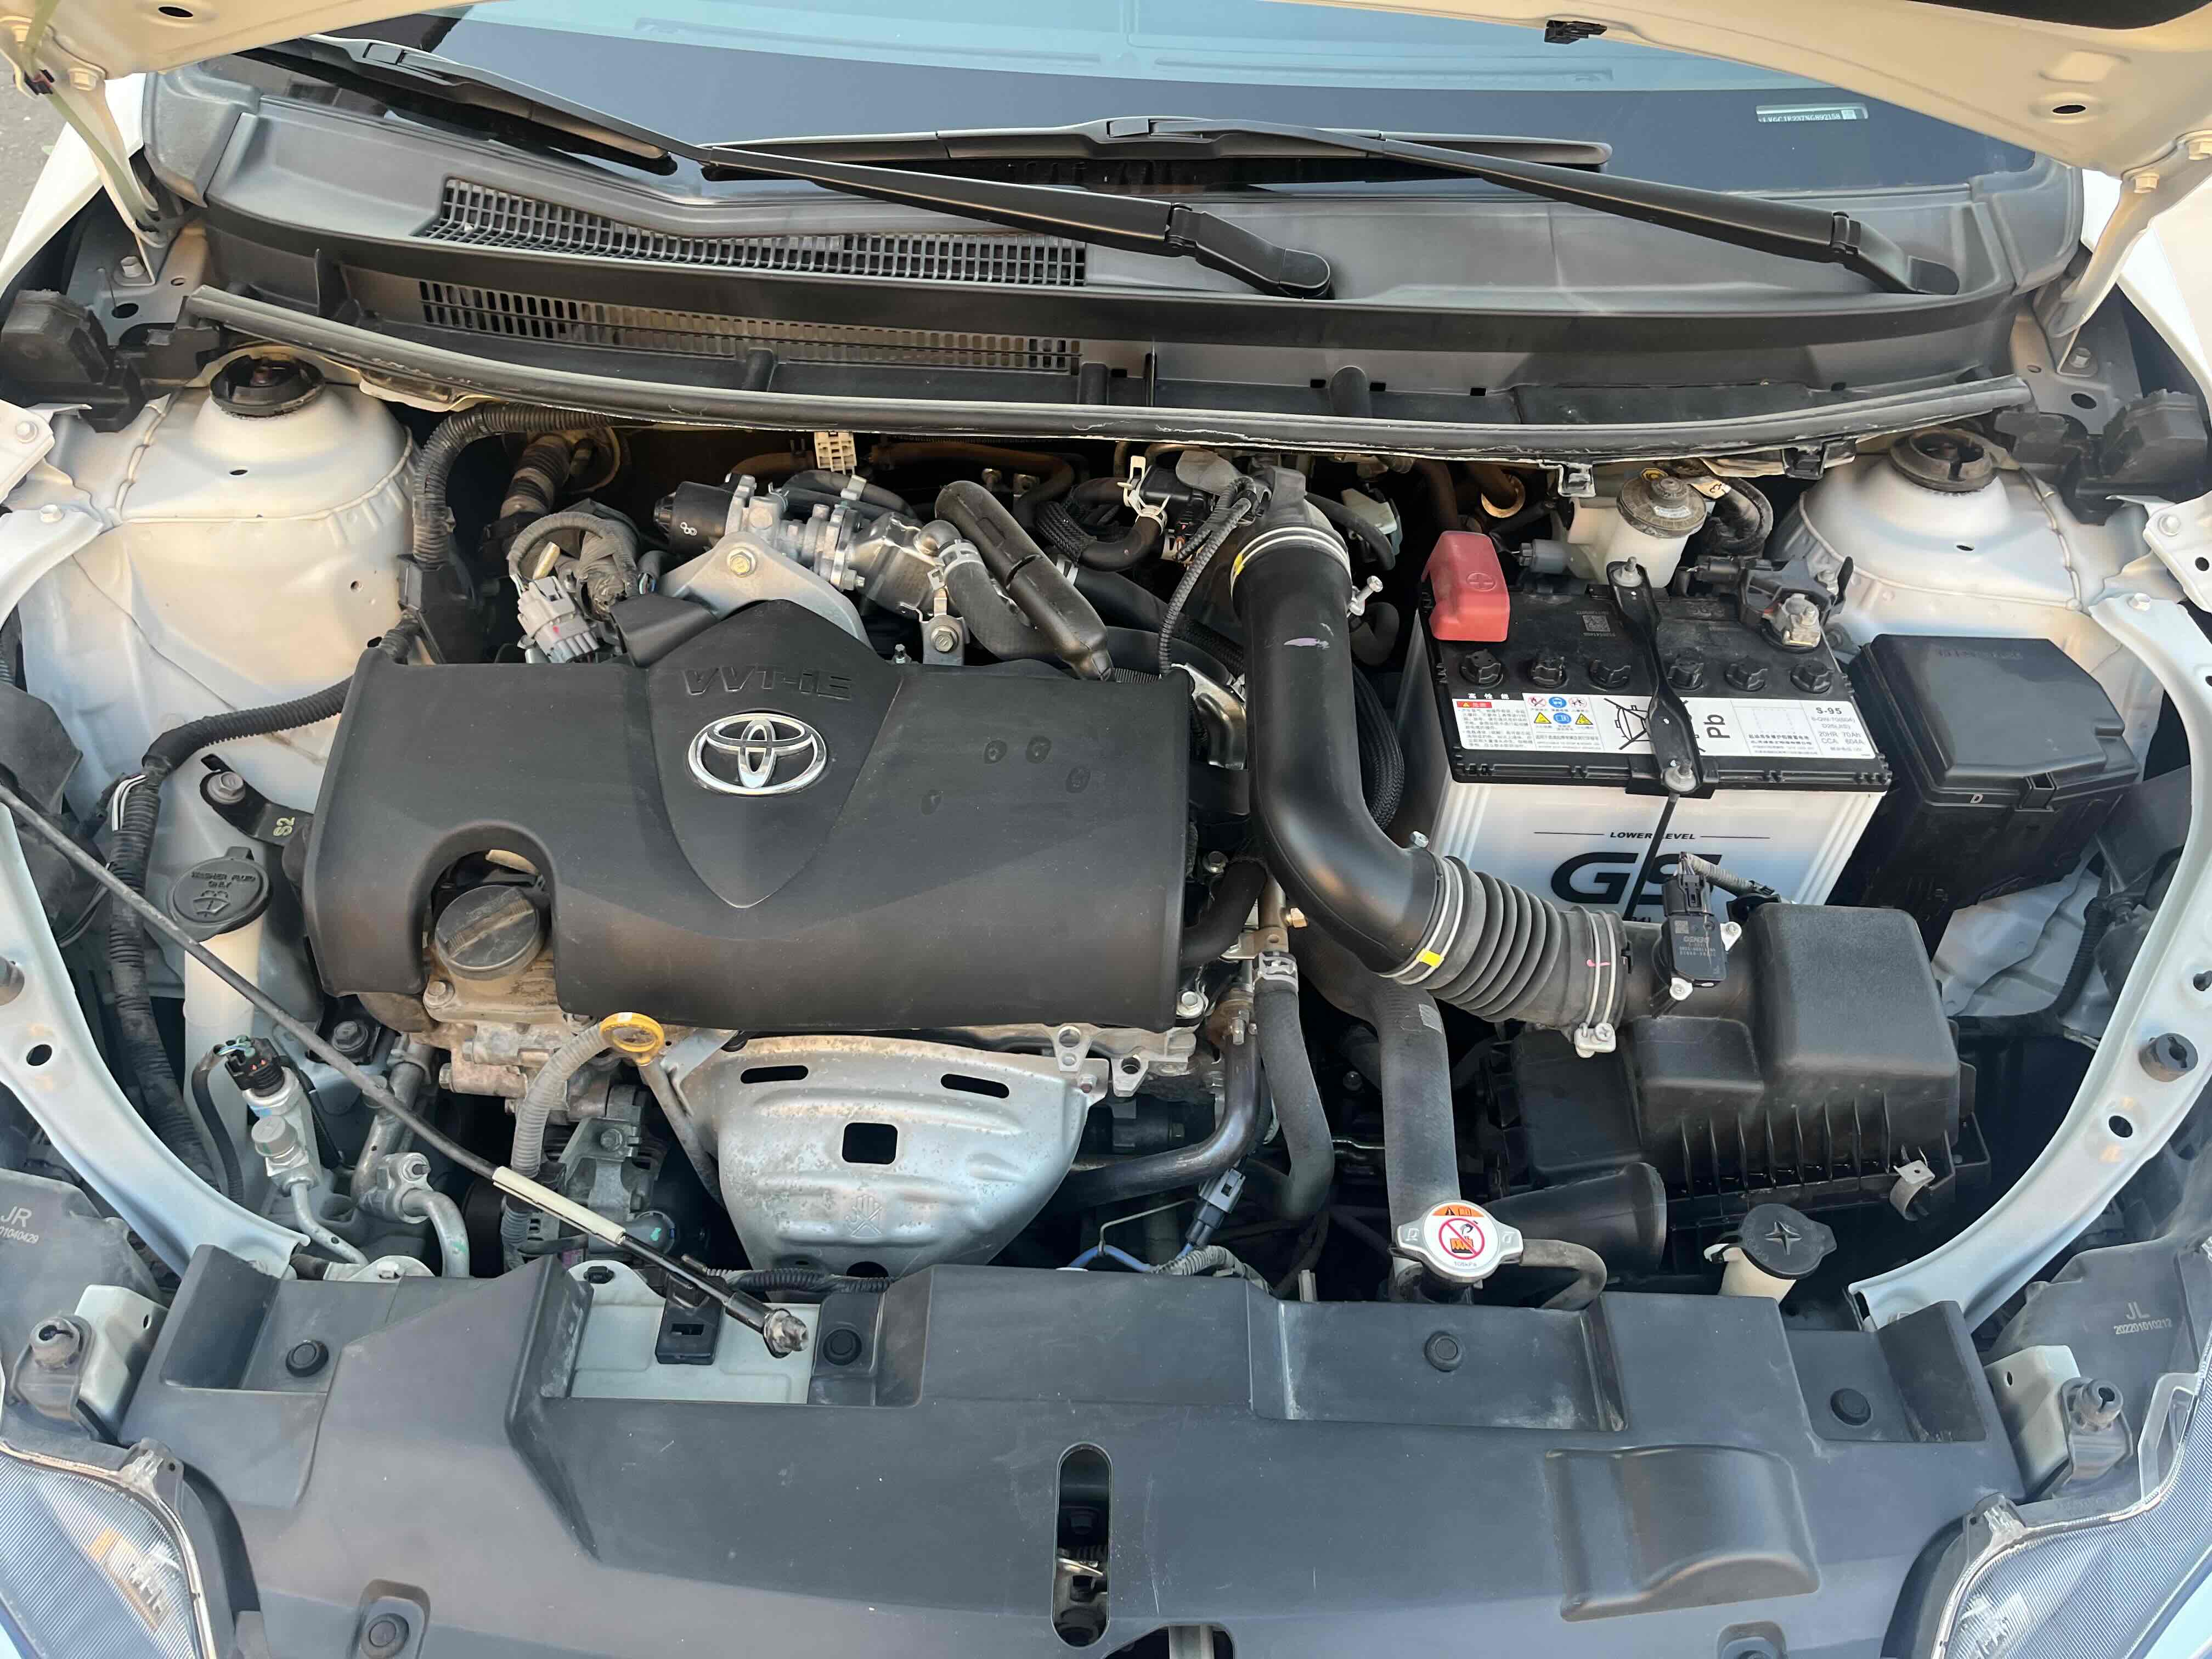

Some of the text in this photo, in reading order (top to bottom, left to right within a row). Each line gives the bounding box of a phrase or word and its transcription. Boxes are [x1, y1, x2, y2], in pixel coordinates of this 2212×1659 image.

[1703, 714, 1730, 738] Pb
[273, 816, 296, 837] S2
[1, 1206, 32, 1228] JR
[2125, 1301, 2151, 1320] JL
